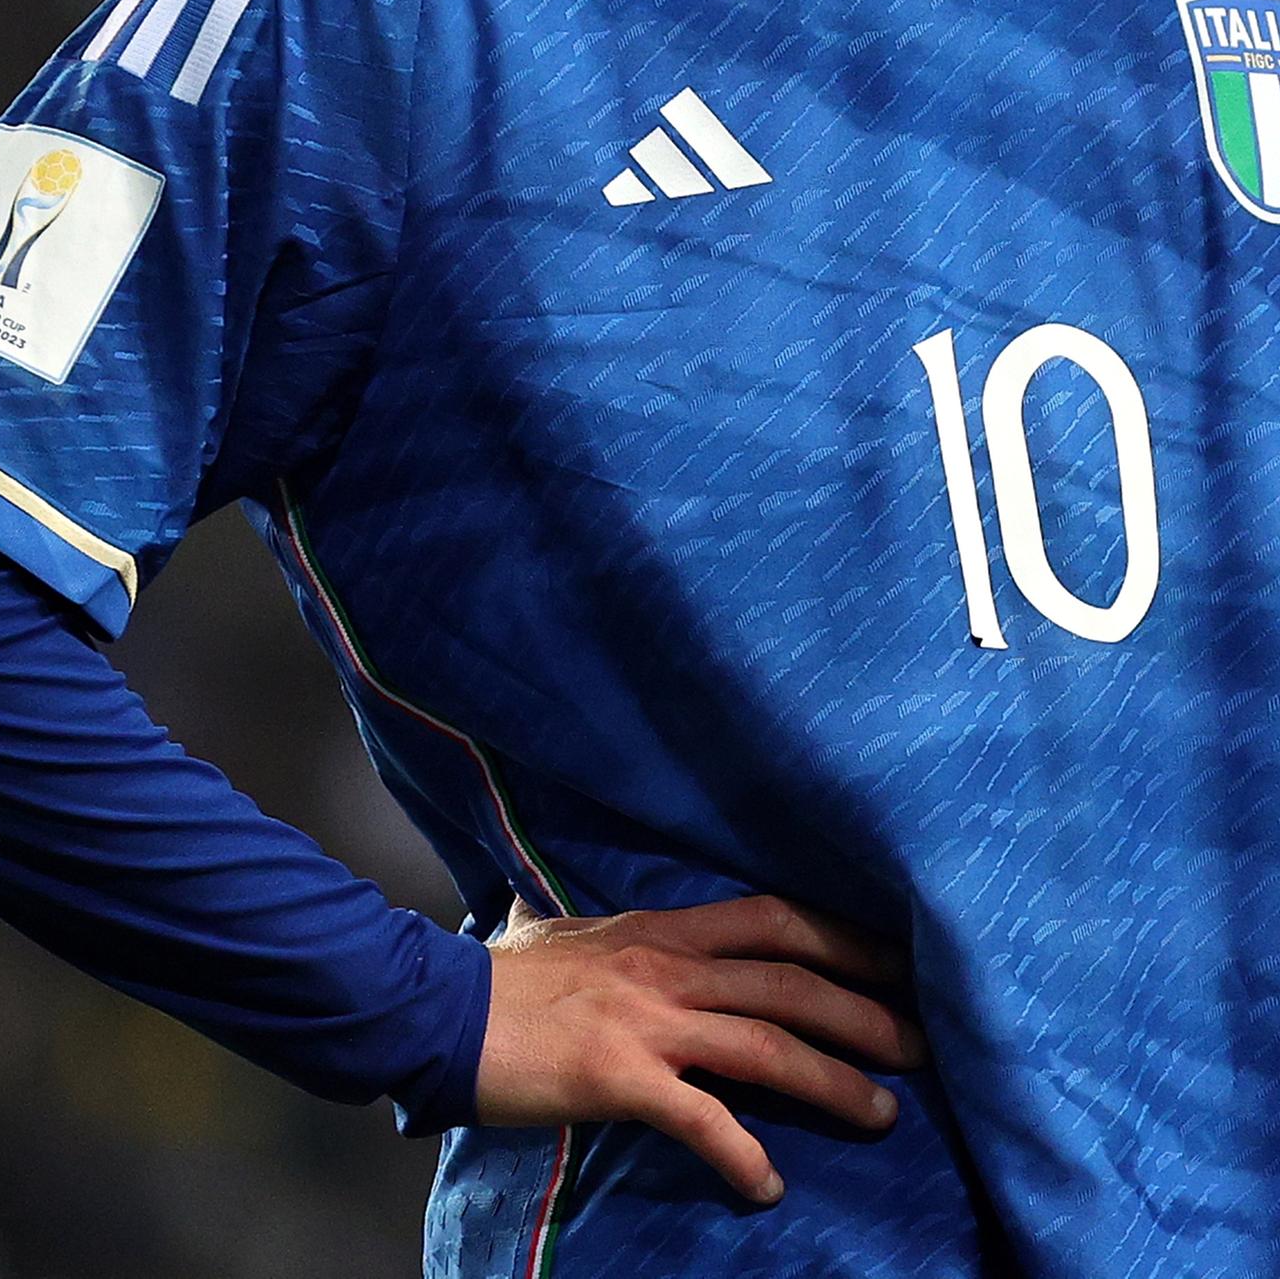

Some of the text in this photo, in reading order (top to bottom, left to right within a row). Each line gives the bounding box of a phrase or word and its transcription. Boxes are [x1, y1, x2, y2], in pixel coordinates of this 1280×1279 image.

[1244, 52, 1275, 69] FIGC
[2, 317, 26, 332] CUP
[912, 323, 1160, 650] 10
